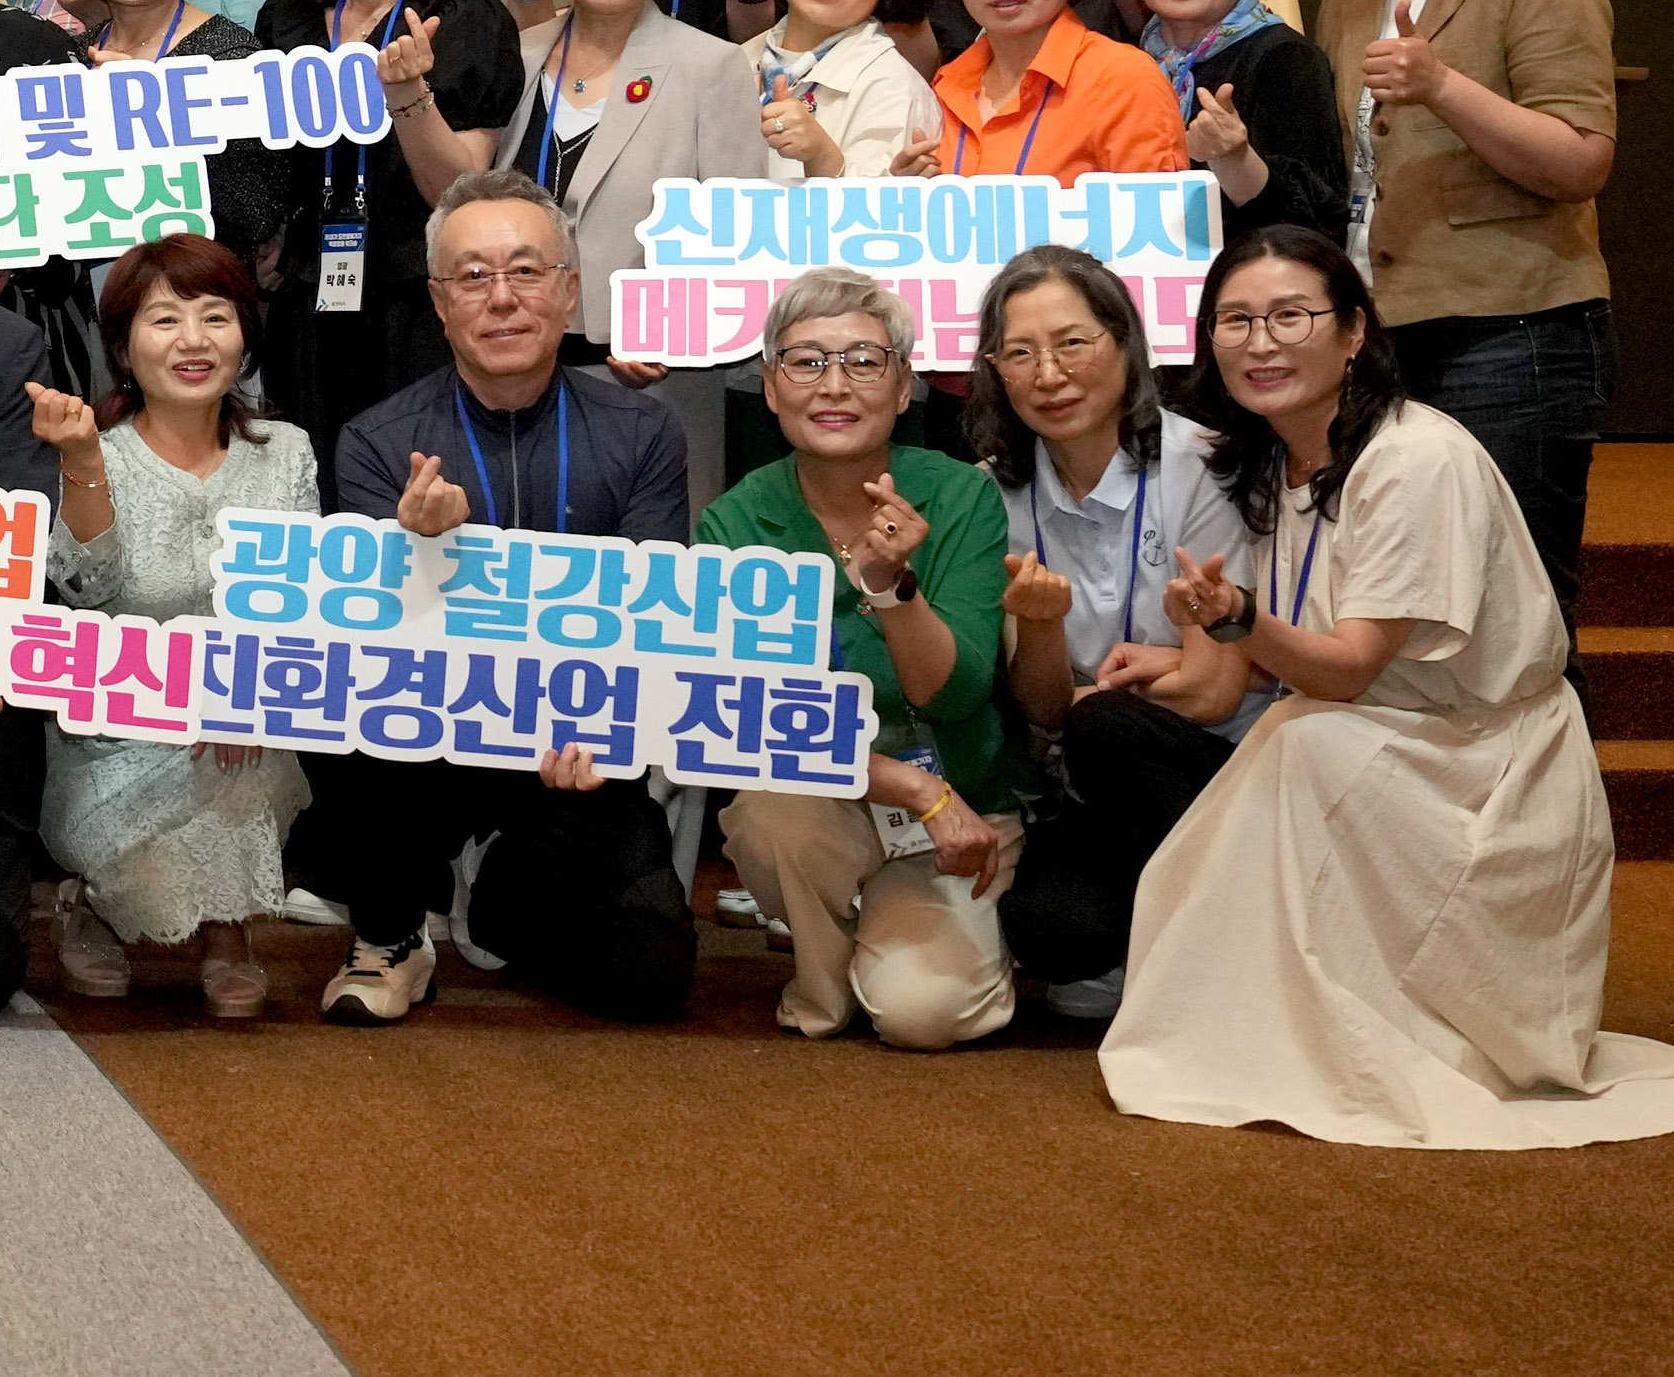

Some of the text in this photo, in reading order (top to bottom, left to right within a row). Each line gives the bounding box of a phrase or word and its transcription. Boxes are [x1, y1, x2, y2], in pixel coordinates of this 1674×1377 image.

[16, 75, 84, 160] 및
[112, 52, 388, 150] RE-100
[64, 163, 205, 249] 조성
[647, 181, 1211, 265] 신재생에너지
[223, 521, 820, 665] 광양 철강산업
[9, 614, 193, 732] 혁신
[669, 669, 865, 785] 전환
